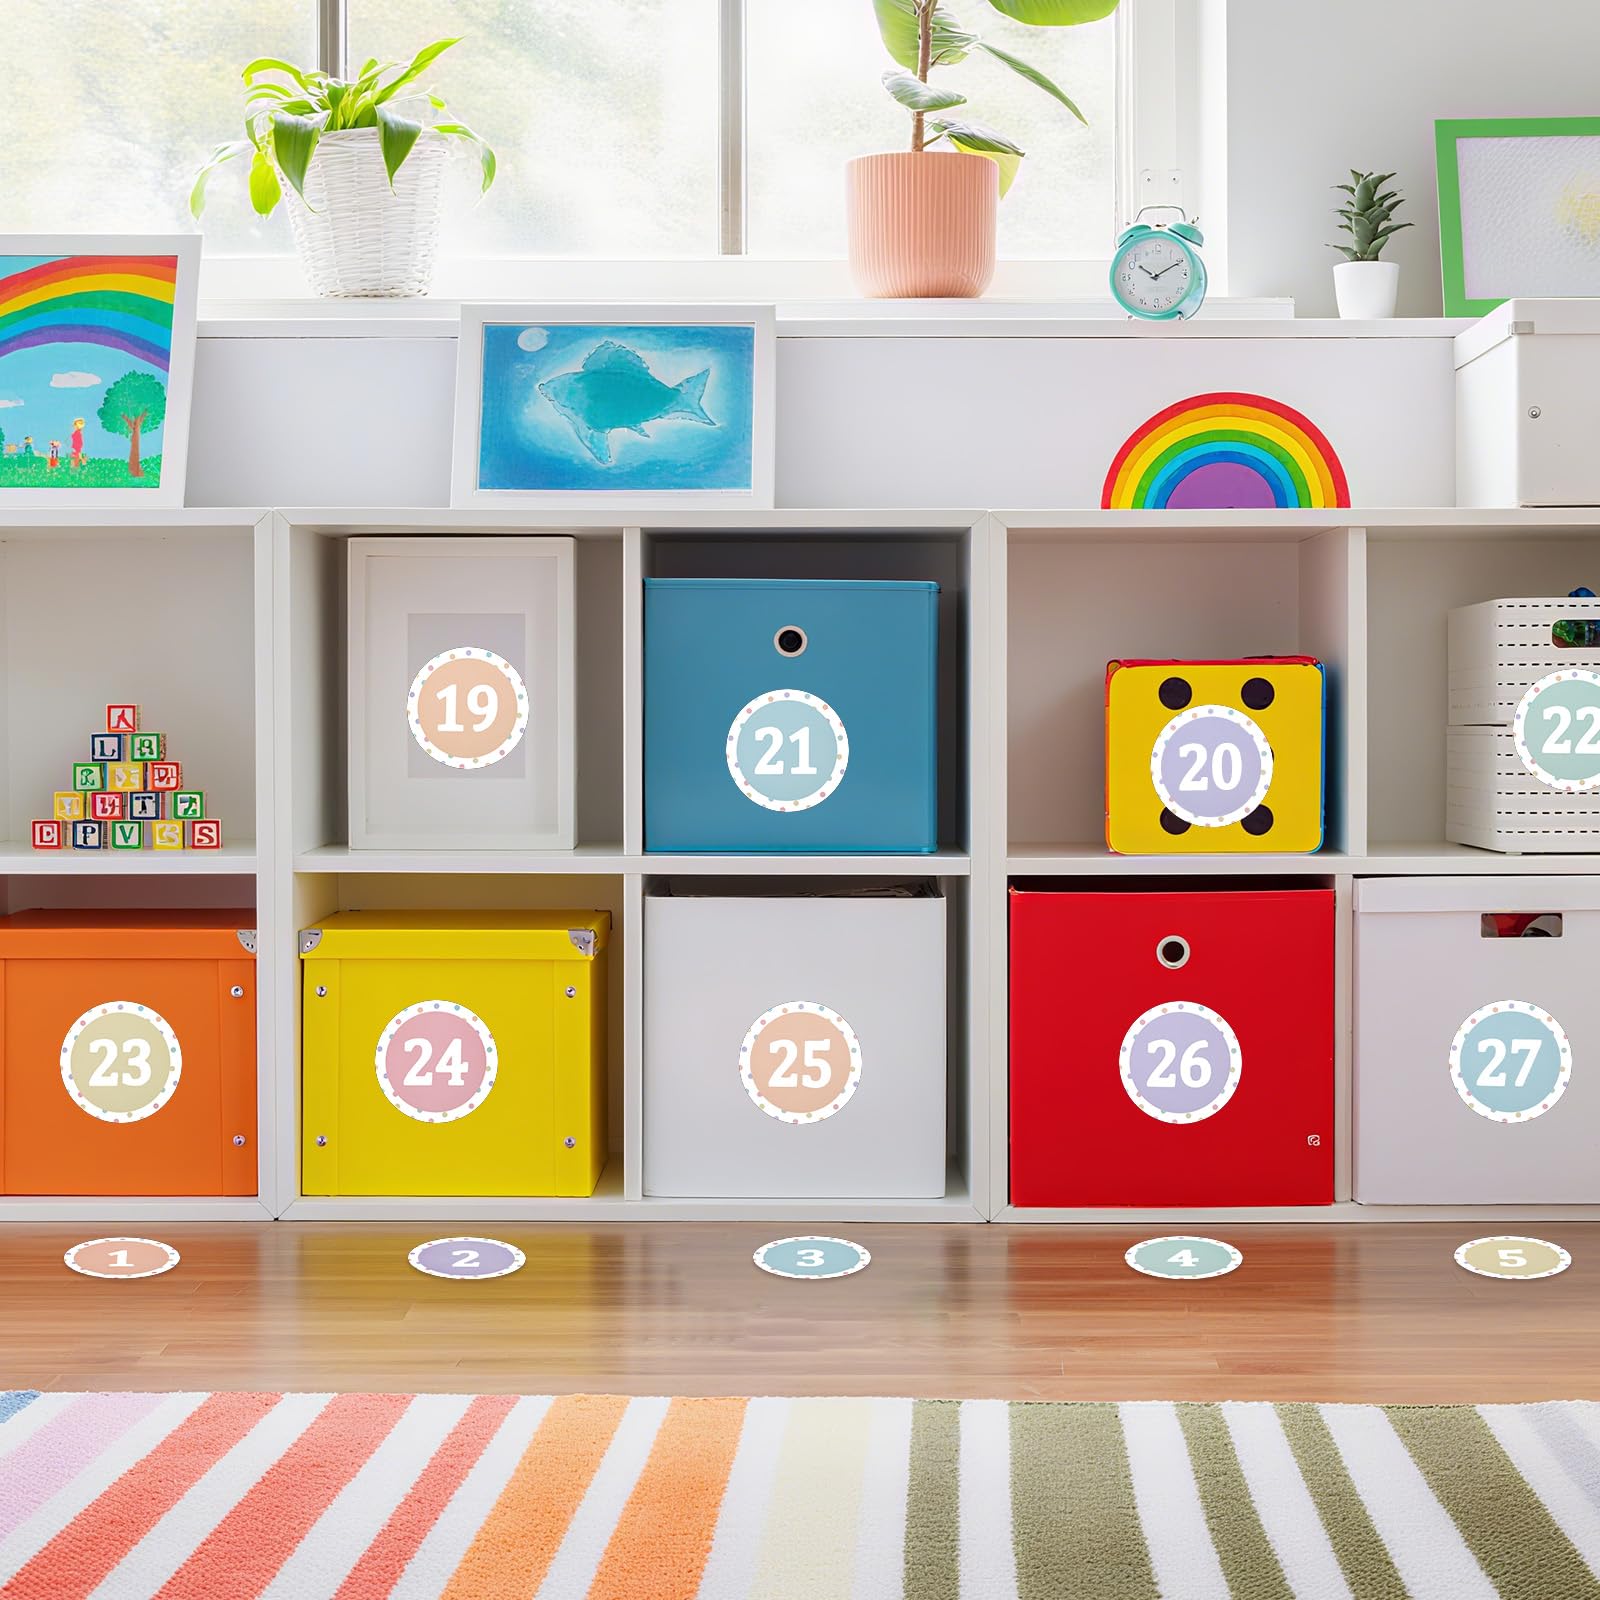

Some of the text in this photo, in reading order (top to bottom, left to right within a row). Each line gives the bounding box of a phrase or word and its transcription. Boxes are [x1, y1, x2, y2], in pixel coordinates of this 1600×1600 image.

[437, 685, 497, 732] 19
[1543, 706, 1600, 753] 22
[99, 740, 117, 757] L
[755, 727, 816, 775] 21
[1180, 743, 1241, 791] 20
[81, 825, 96, 845] P
[119, 825, 134, 844] V
[196, 826, 214, 844] S
[90, 1040, 150, 1086] 23
[404, 1039, 468, 1086] 24
[769, 1040, 831, 1088] 25
[1147, 1040, 1211, 1087] 26
[1477, 1039, 1541, 1087] 27
[110, 1250, 133, 1267] 1
[452, 1250, 480, 1267] 2
[797, 1250, 825, 1267] 3
[1167, 1250, 1199, 1267] 4
[1498, 1250, 1527, 1267] 5
